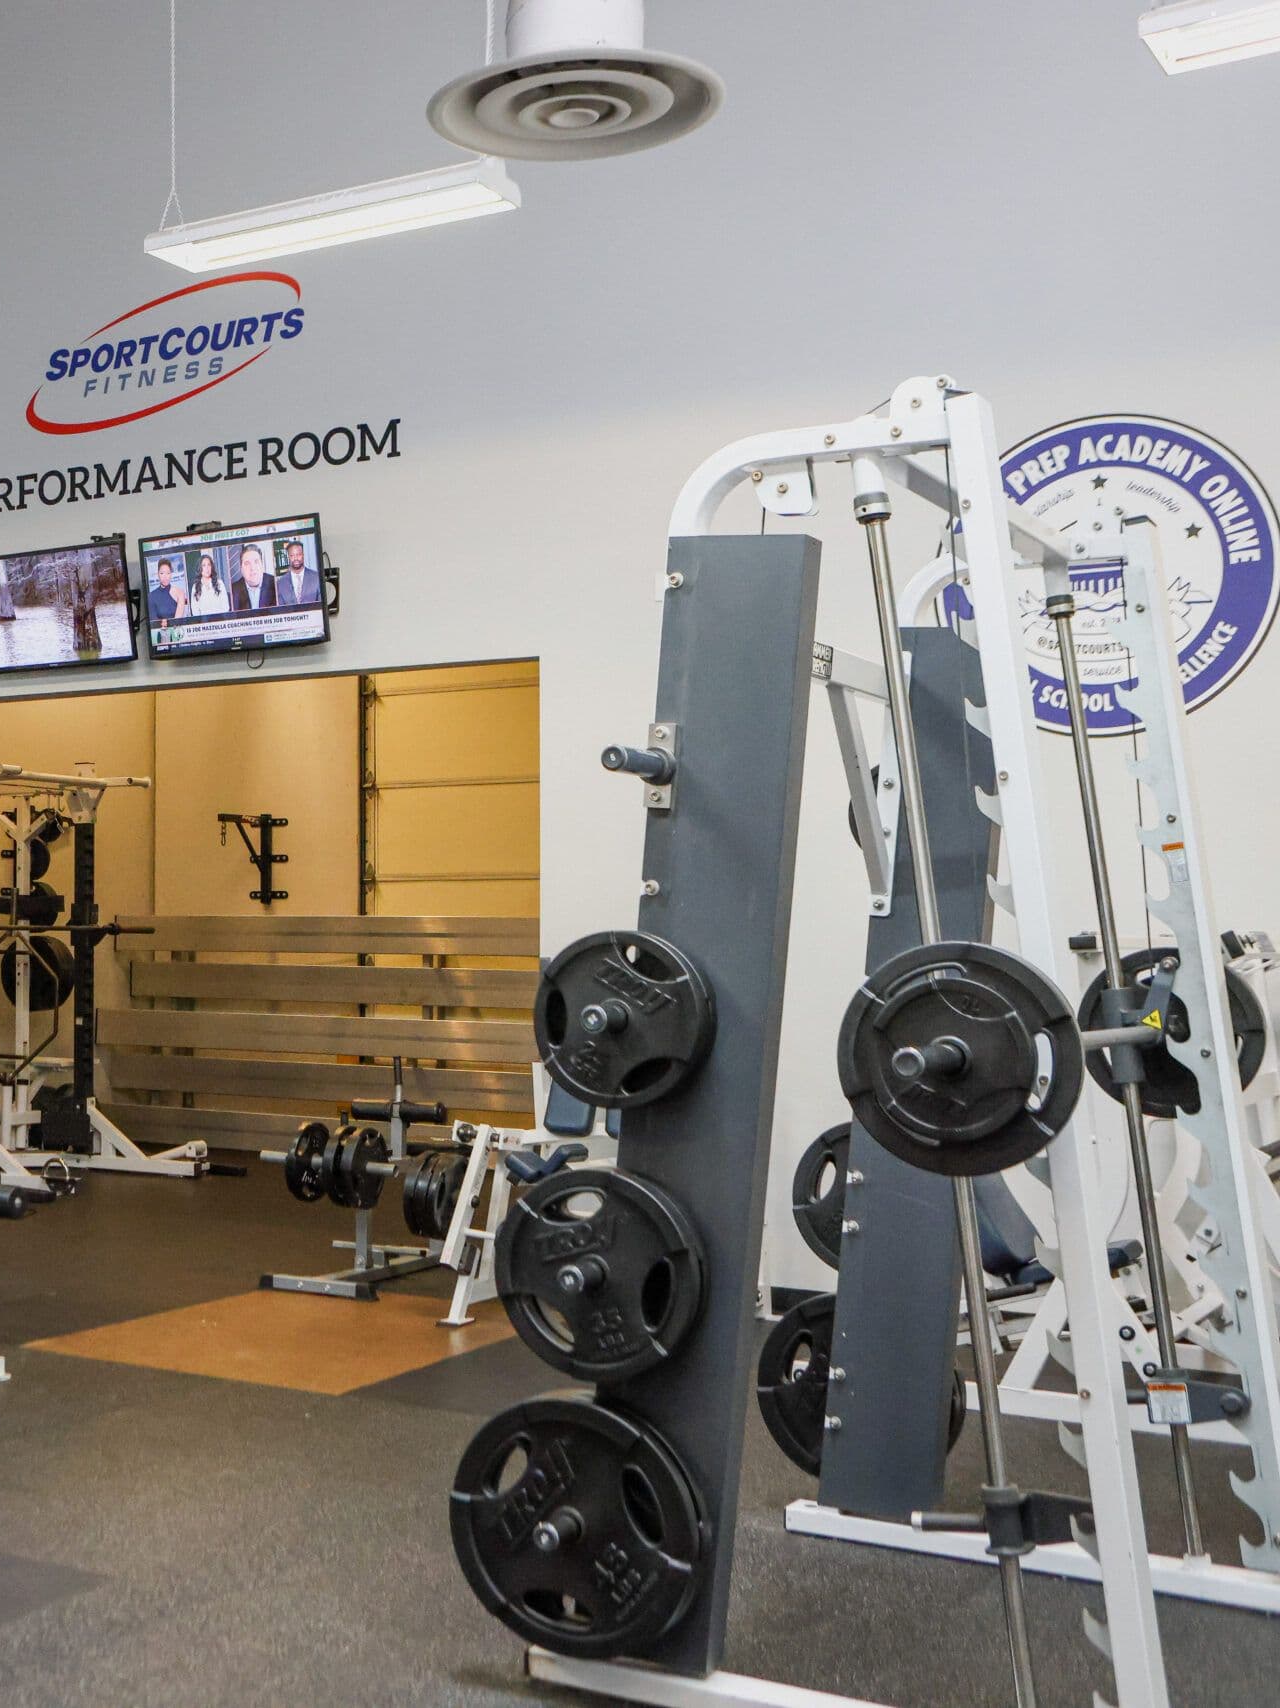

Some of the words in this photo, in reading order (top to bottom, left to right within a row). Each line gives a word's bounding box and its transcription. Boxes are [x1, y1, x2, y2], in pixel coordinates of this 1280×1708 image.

[45, 308, 305, 381] SPORTCOURTS
[83, 357, 224, 398] FITNESS
[258, 418, 402, 476] ROOM
[1005, 444, 1071, 497] PREP
[1078, 434, 1211, 483] ACADEMY
[1199, 475, 1262, 565] ONLINE
[1178, 620, 1238, 685] ELLENCE
[1039, 685, 1114, 713] SCOL
